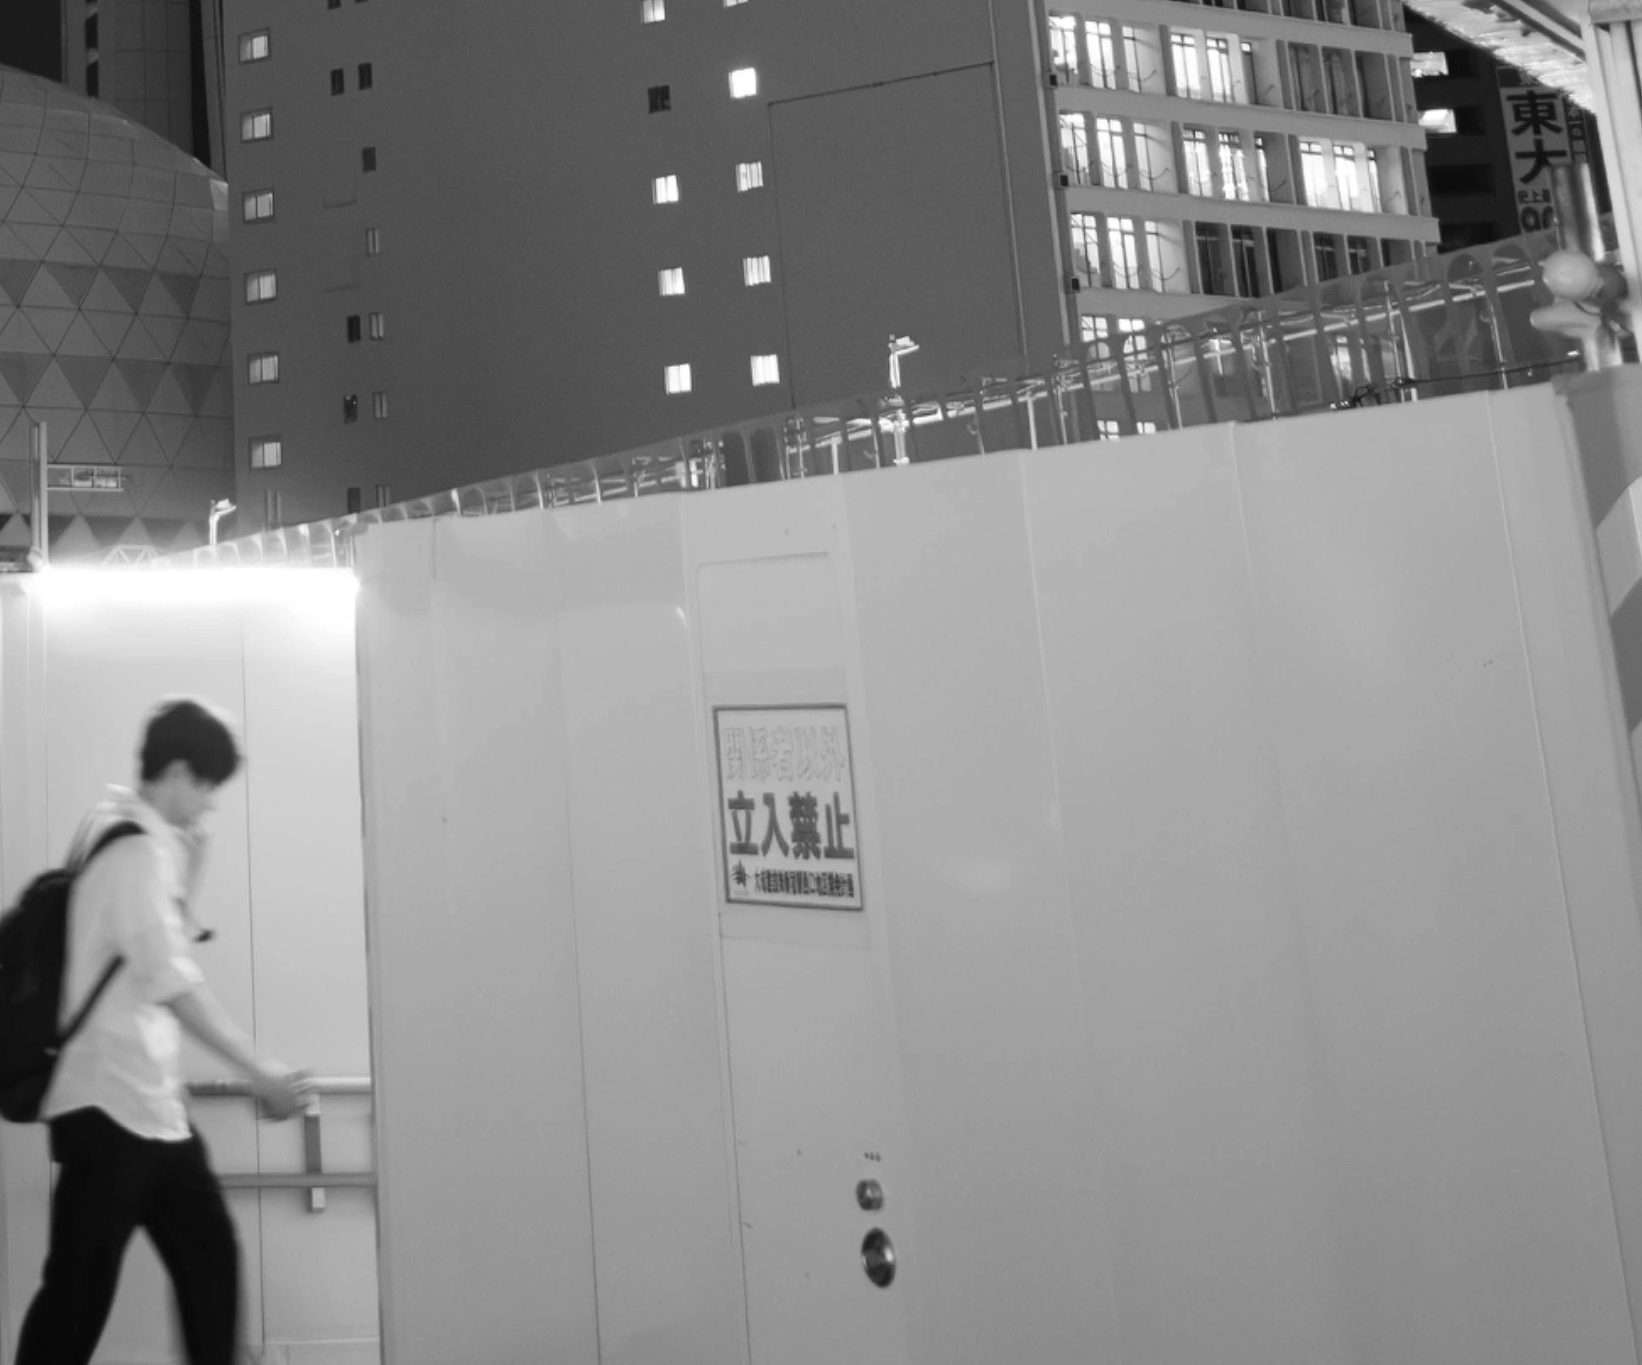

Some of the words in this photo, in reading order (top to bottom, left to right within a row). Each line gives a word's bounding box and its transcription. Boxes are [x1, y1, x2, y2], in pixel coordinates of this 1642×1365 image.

[1506, 90, 1567, 184] 東大
[727, 790, 856, 861] 立入禁止
